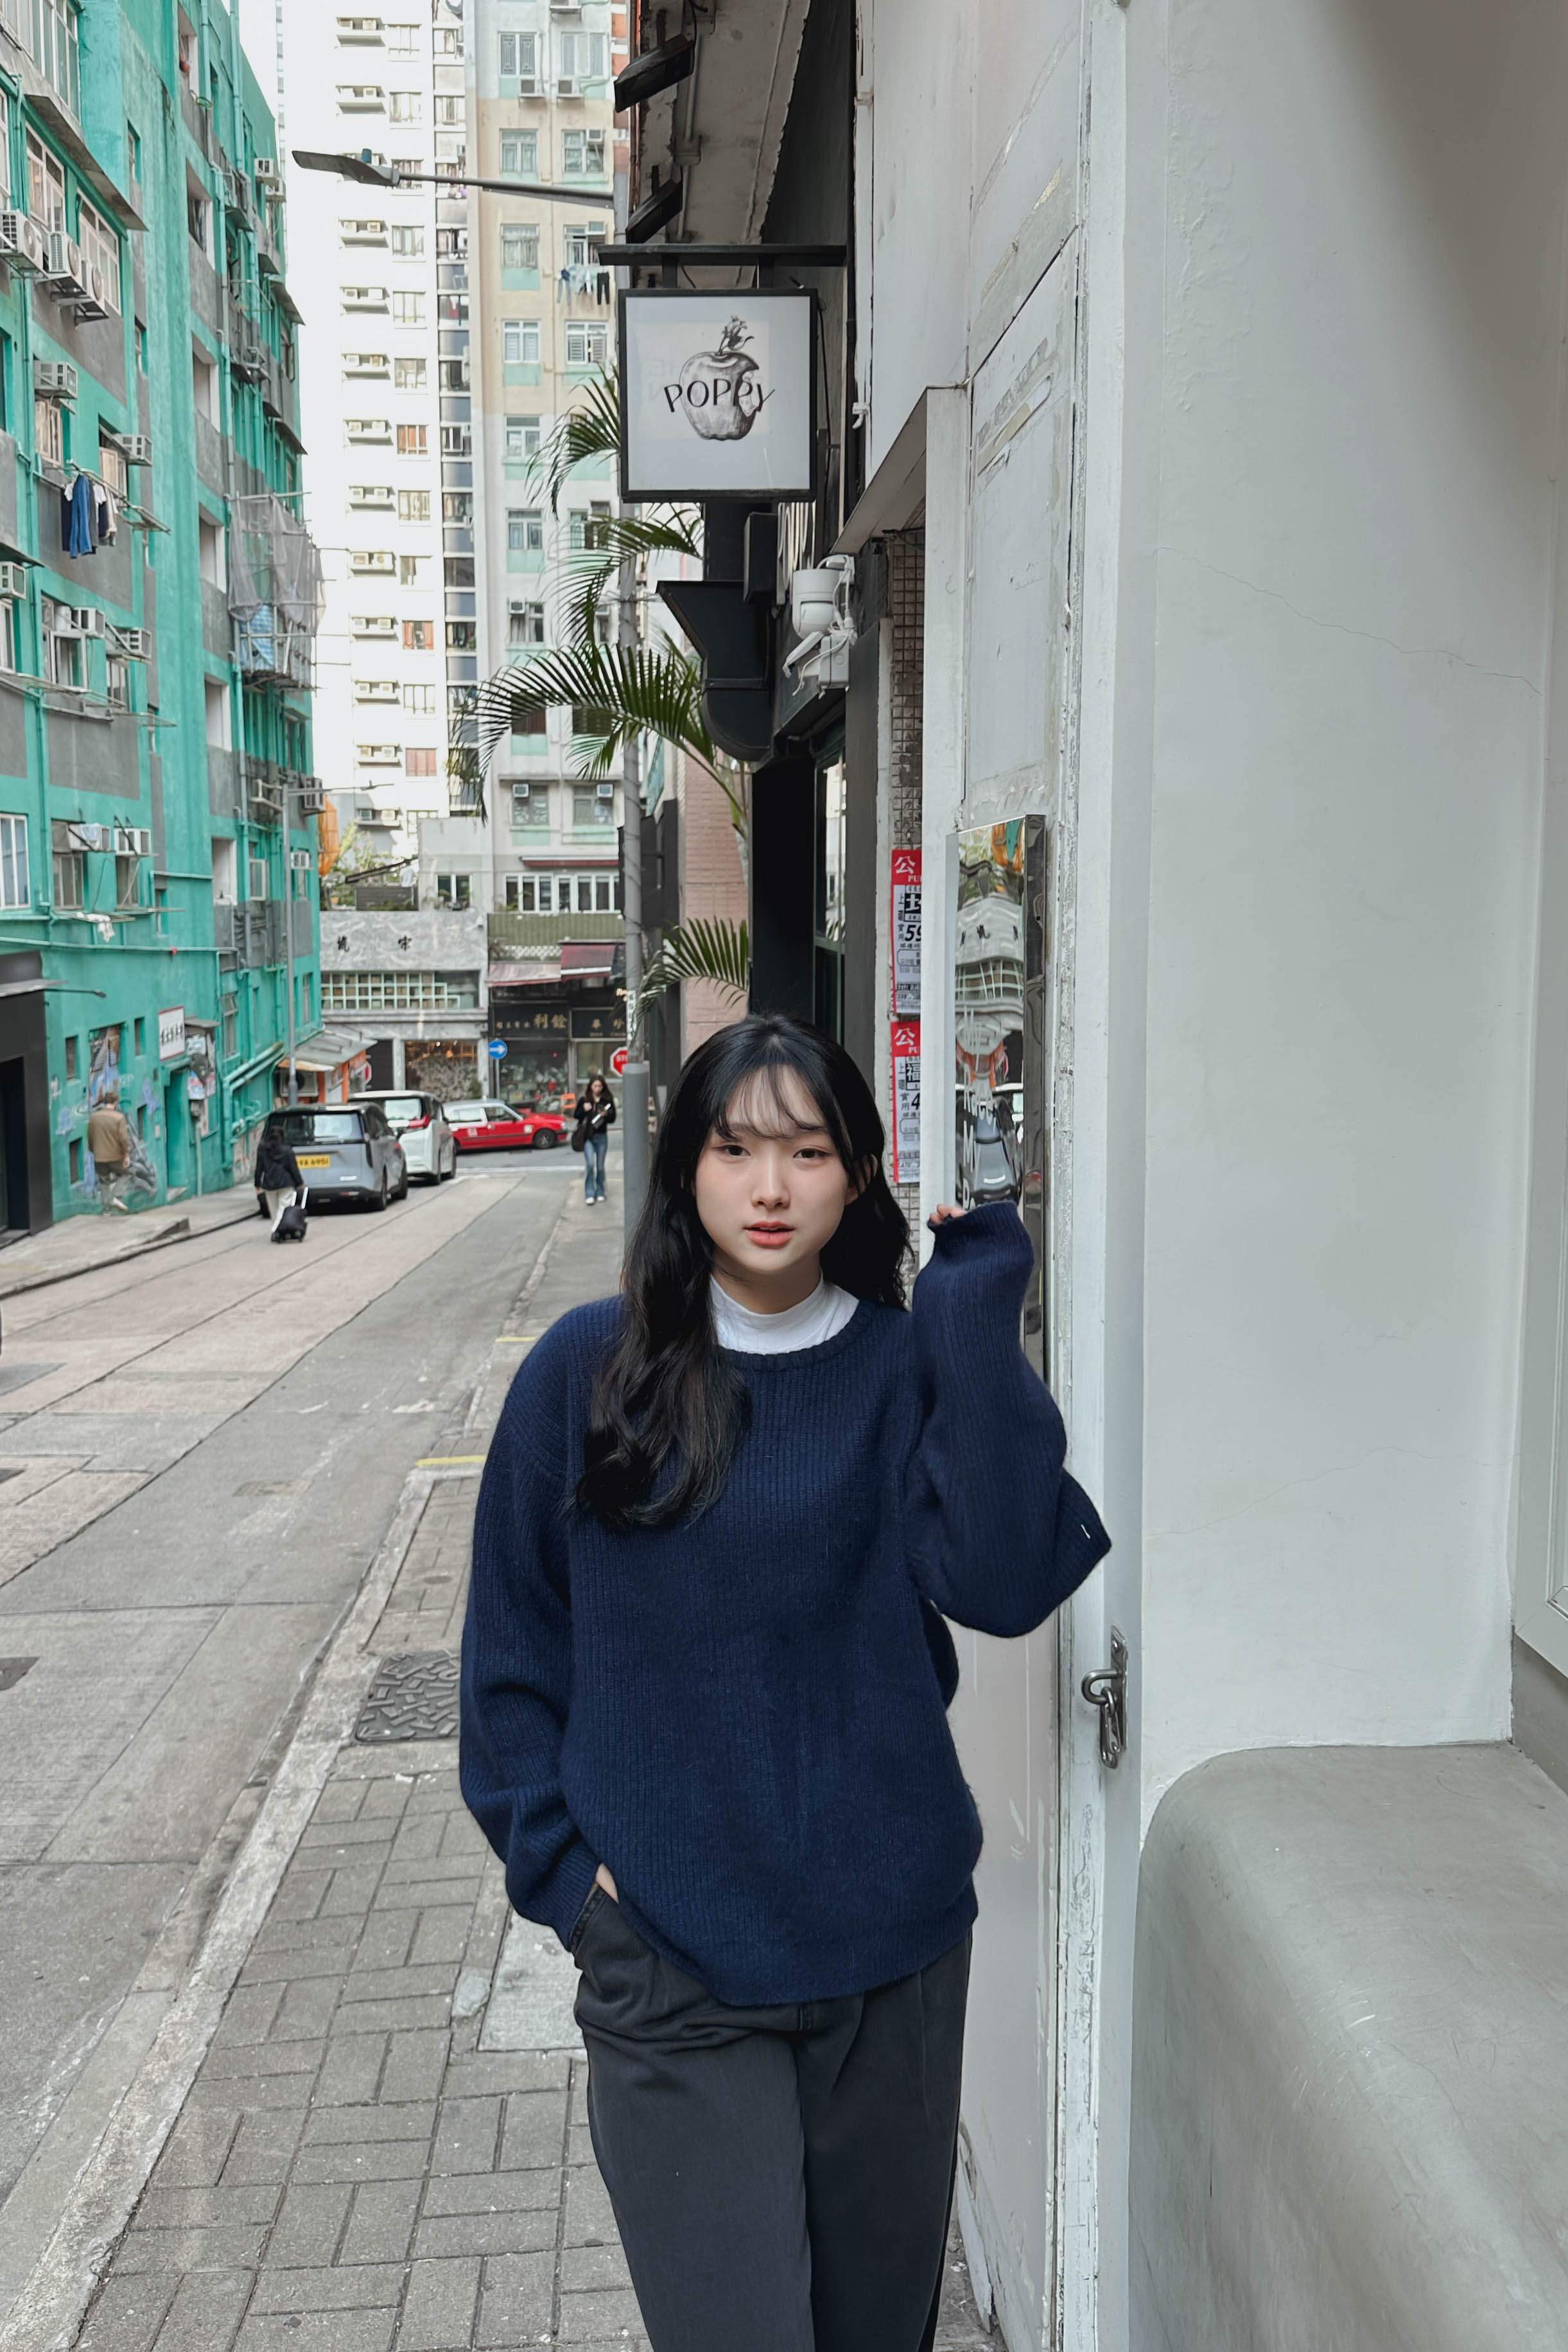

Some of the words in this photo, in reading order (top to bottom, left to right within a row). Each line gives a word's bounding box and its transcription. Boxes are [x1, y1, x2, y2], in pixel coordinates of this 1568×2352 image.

[664, 378, 776, 413] POPPY
[894, 855, 916, 875] 公
[908, 875, 921, 883] PU
[894, 1028, 915, 1046] 公
